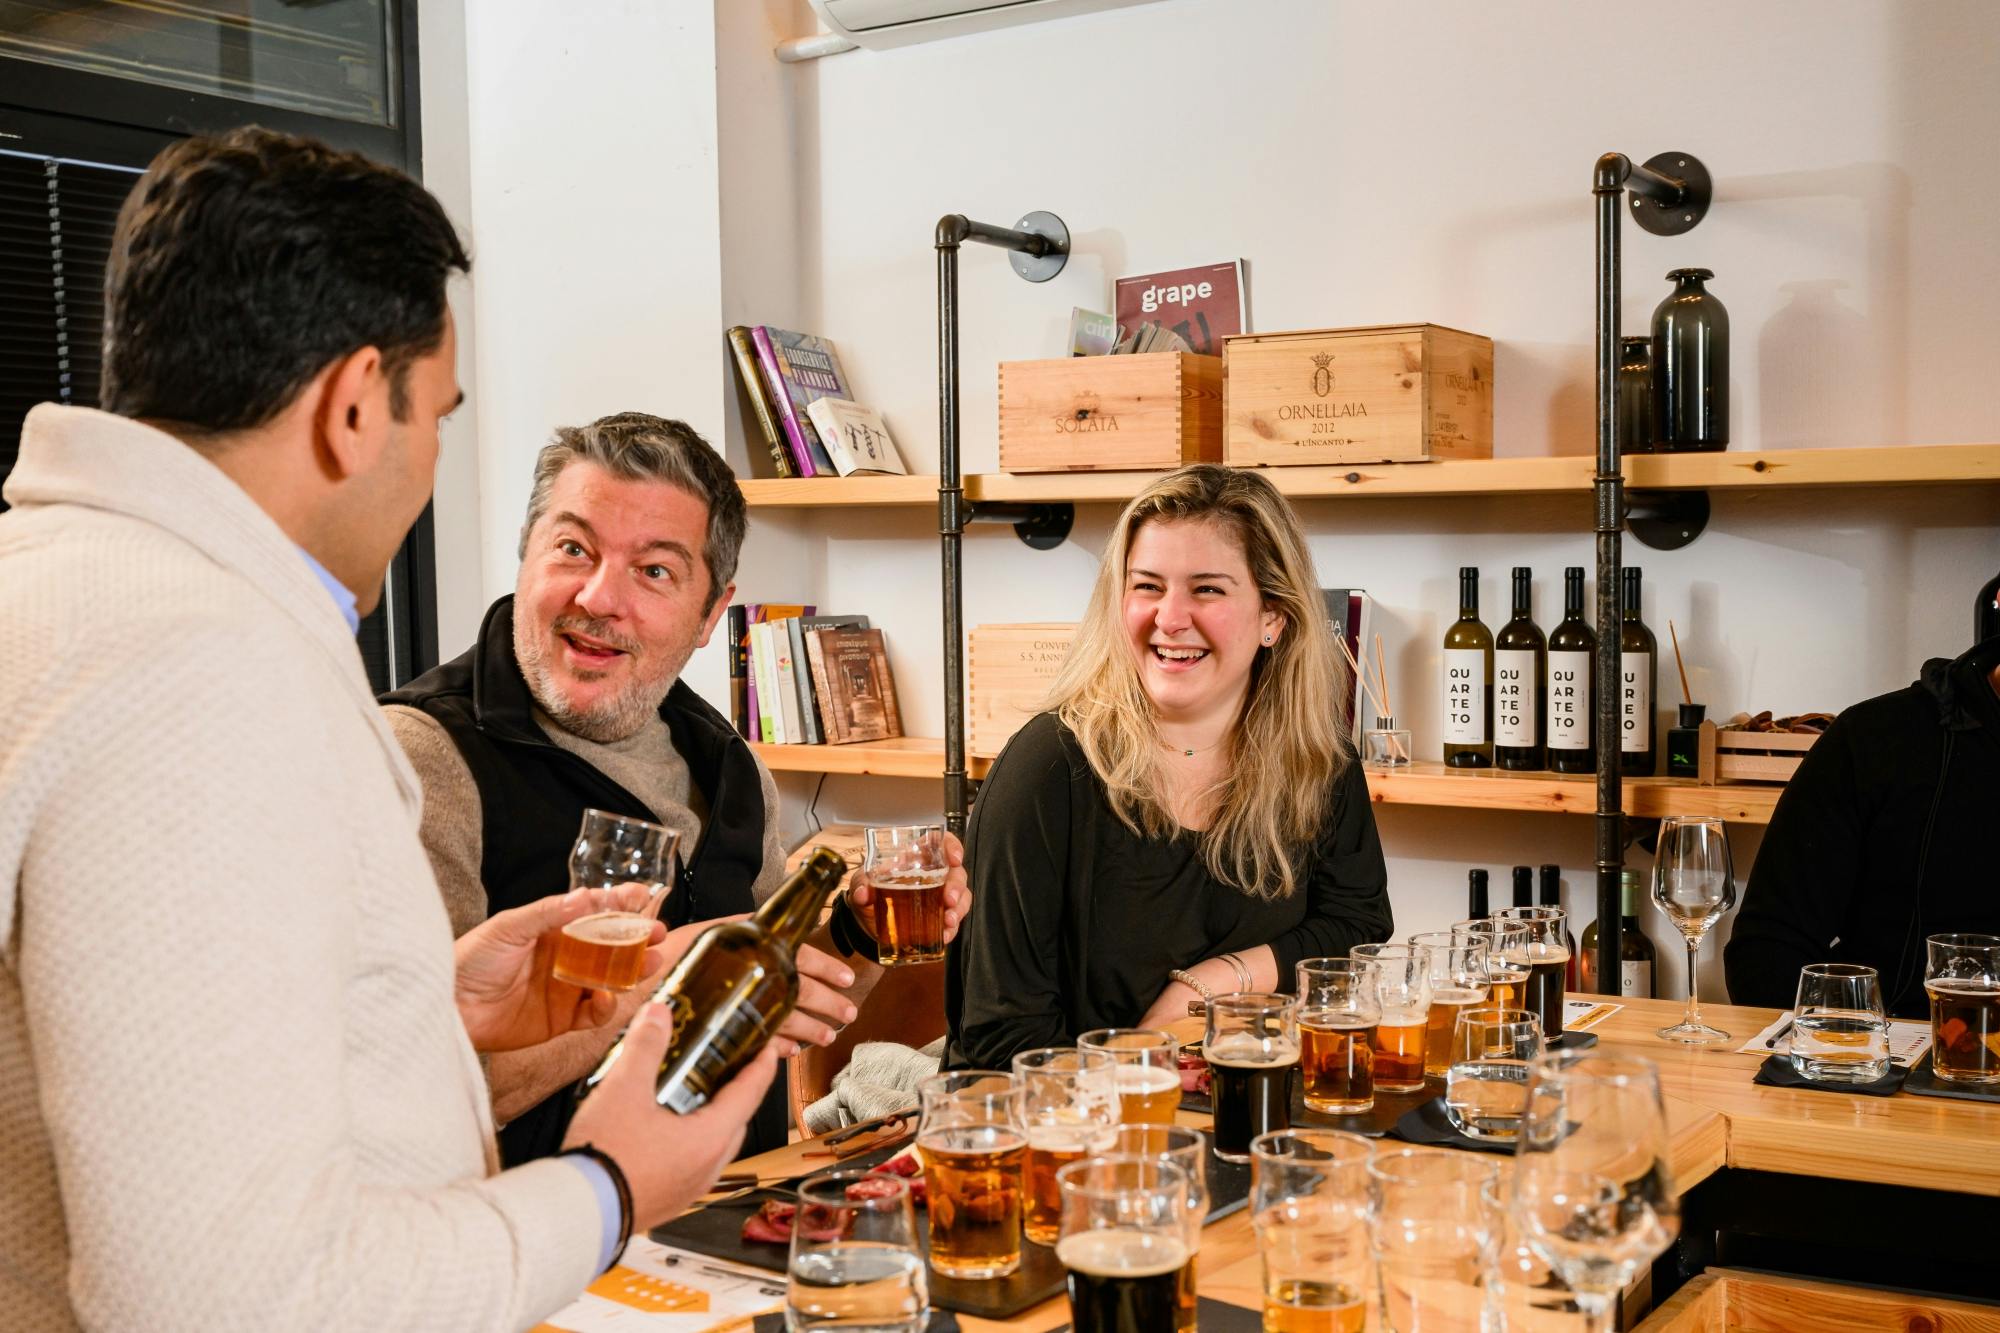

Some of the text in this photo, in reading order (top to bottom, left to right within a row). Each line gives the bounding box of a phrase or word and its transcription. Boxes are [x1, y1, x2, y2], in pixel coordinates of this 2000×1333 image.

[1141, 281, 1213, 312] grape
[1278, 401, 1368, 421] ORNELLAIA
[1311, 422, 1335, 434] 2012
[1450, 668, 1470, 679] QU
[1500, 670, 1519, 680] QU
[1554, 671, 1574, 682] QU
[1624, 672, 1635, 683] U
[1450, 684, 1470, 694] AR
[1500, 685, 1519, 695] AR
[1554, 686, 1574, 697] AR
[1625, 688, 1635, 699] R
[1450, 699, 1469, 709] TE
[1501, 700, 1519, 710] TE
[1554, 702, 1574, 713] TE
[1624, 704, 1634, 715] E
[1450, 713, 1470, 724] TO
[1501, 715, 1520, 726] TO
[1554, 717, 1575, 728] TO
[1623, 719, 1635, 730] O
